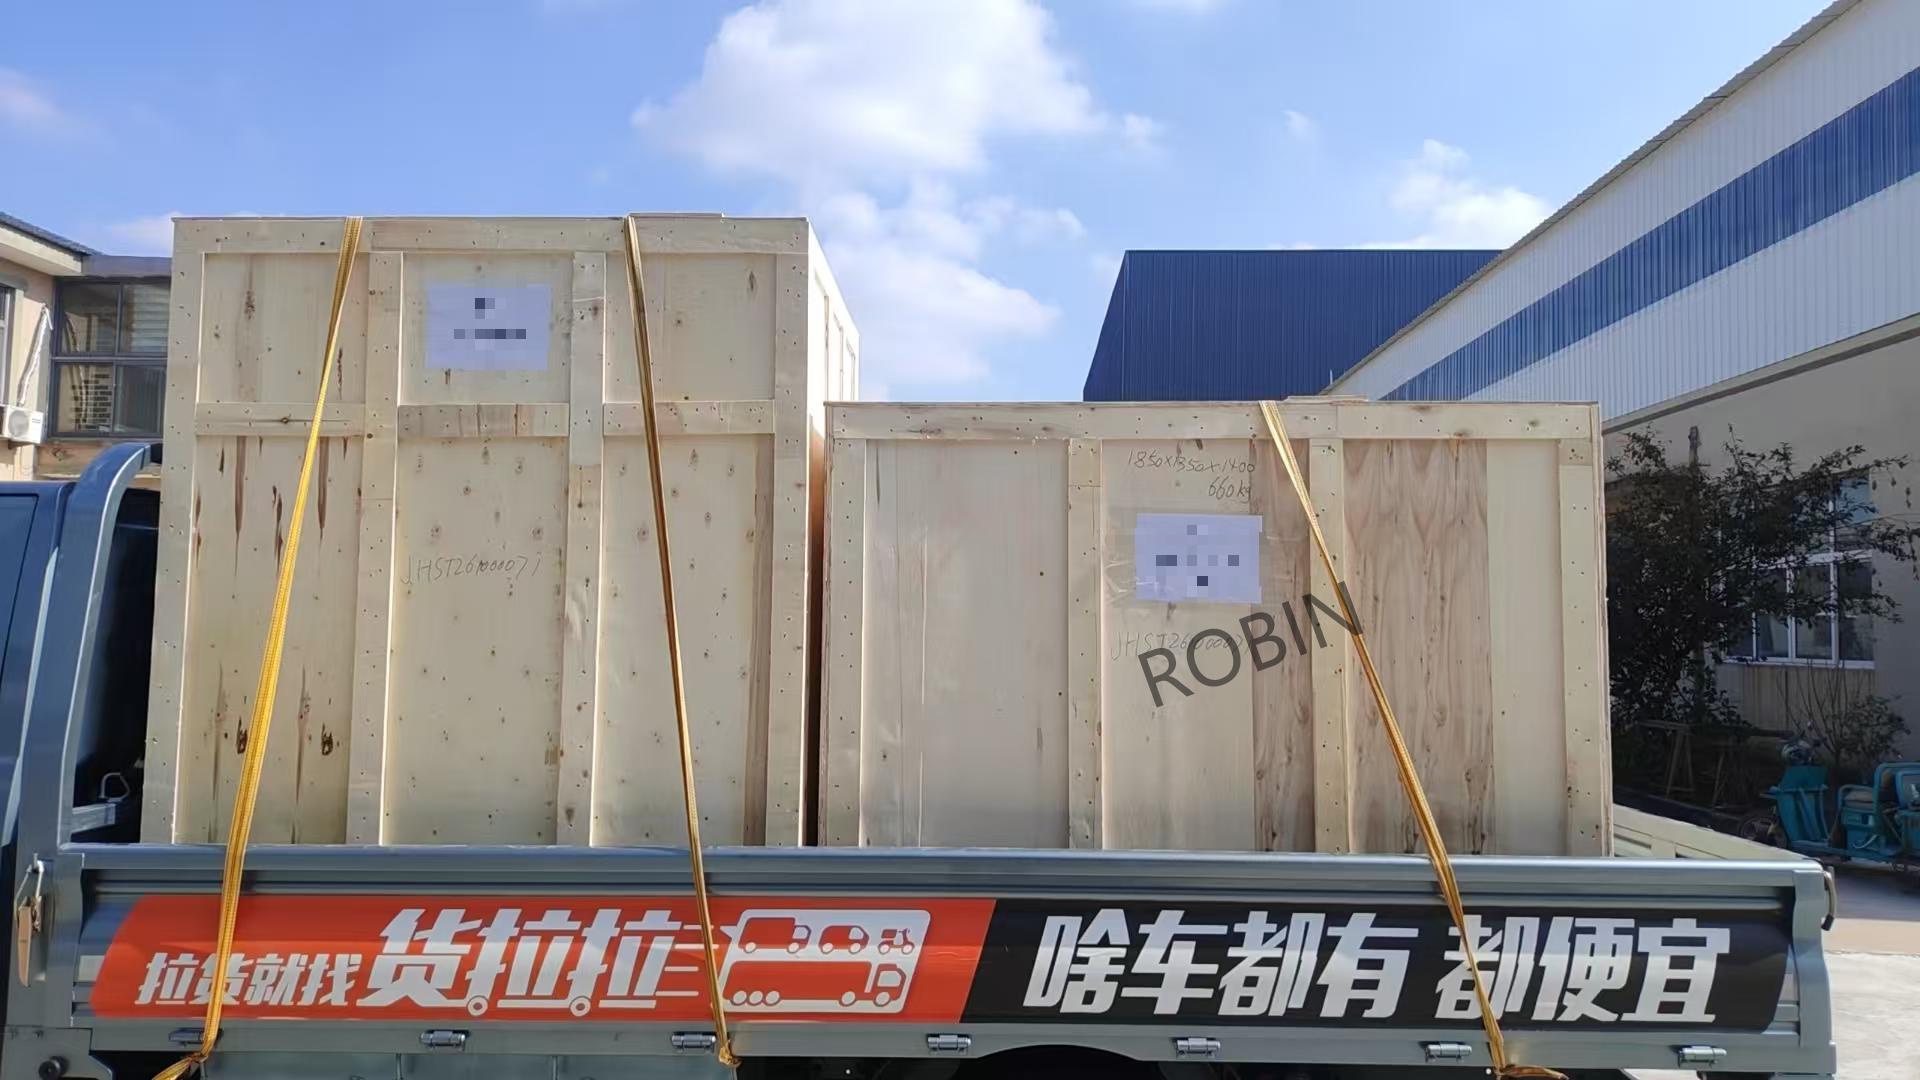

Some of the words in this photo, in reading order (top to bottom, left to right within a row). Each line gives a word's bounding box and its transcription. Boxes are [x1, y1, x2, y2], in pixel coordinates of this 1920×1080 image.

[135, 952, 362, 1005] 拉货就找
[356, 908, 671, 1017] 货拉拉
[1023, 908, 1418, 1018] 啥车都有
[1434, 914, 1730, 1023] 都便宜
